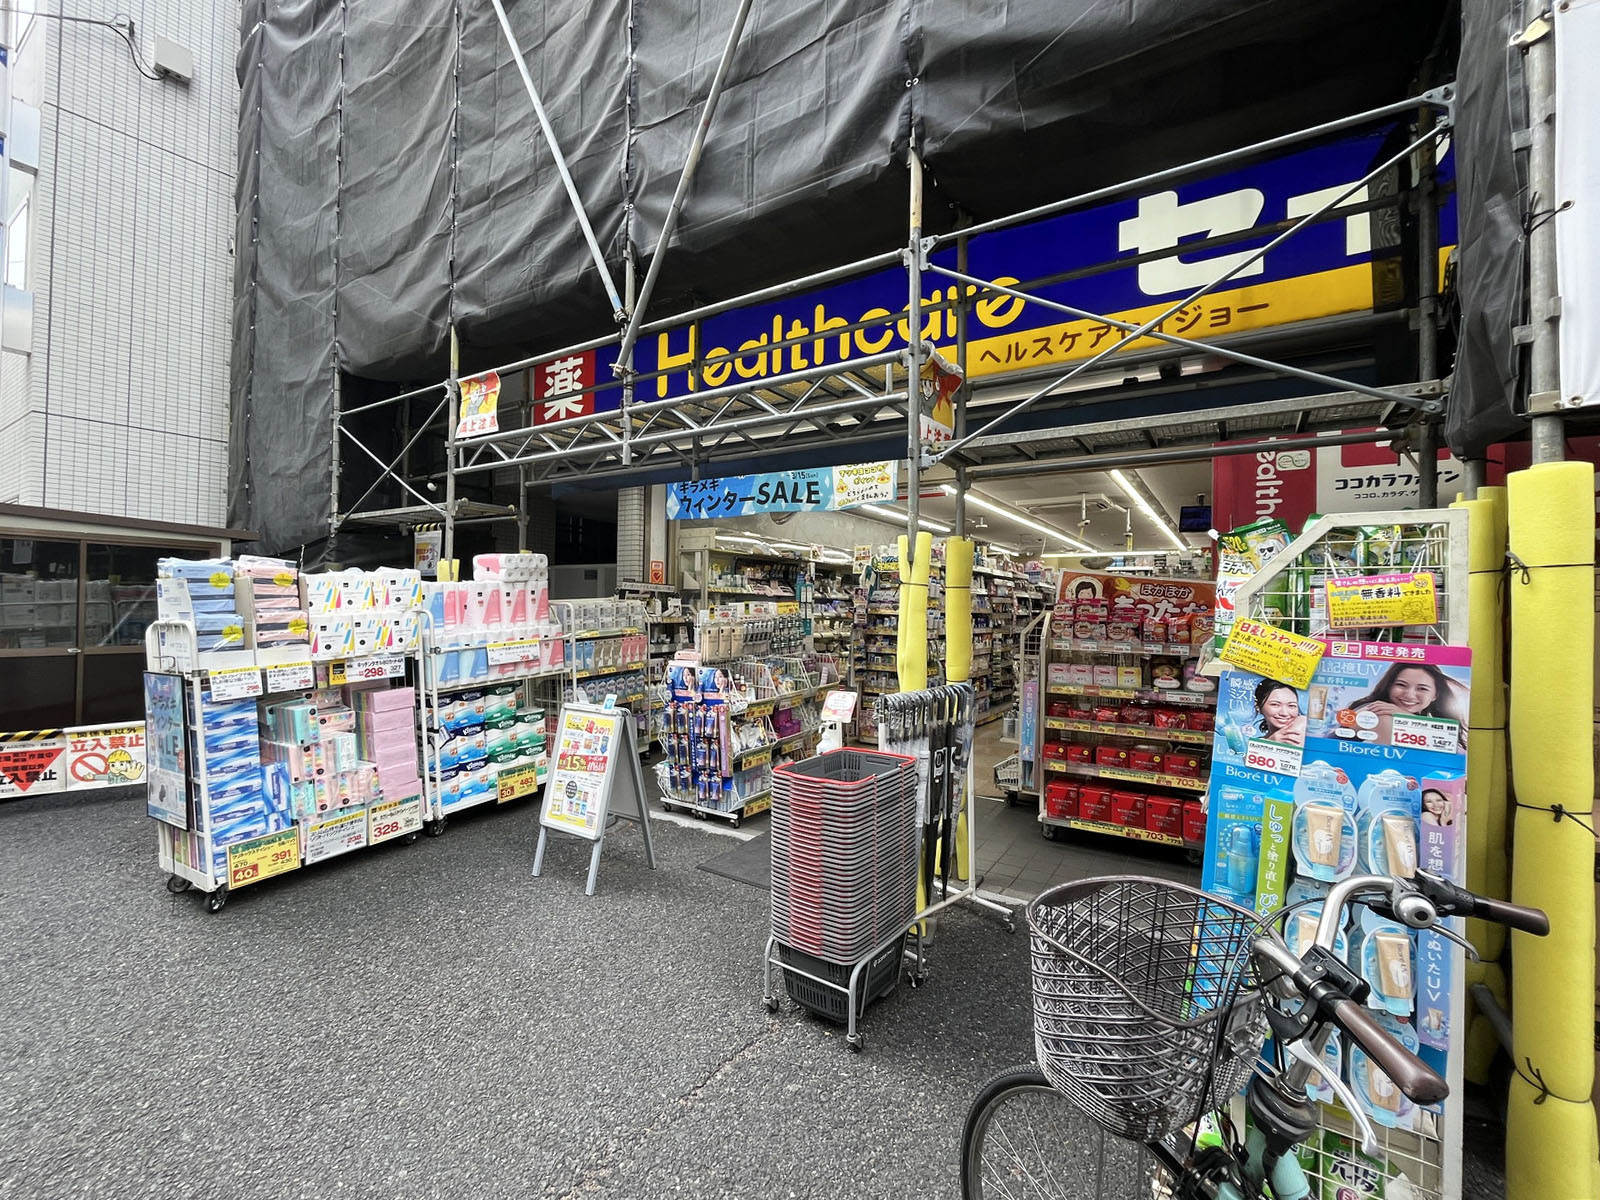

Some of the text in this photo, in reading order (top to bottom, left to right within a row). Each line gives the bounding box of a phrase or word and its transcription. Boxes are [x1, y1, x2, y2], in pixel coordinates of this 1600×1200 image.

[656, 275, 1027, 399] Healthcare
[543, 356, 584, 421] 薬
[679, 480, 720, 494] キラメキ
[1365, 644, 1426, 659] 限定発売
[364, 666, 384, 678] 298
[1228, 688, 1258, 701] ミスト
[70, 734, 145, 753] 立入禁止
[1339, 742, 1408, 761] Bioré UV
[1247, 754, 1276, 769] 980
[1176, 777, 1195, 787] 703
[1225, 765, 1285, 786] Bioré UV
[374, 821, 399, 838] 328
[1146, 831, 1164, 841] 703
[271, 849, 291, 862] 391
[235, 868, 253, 881] 40
